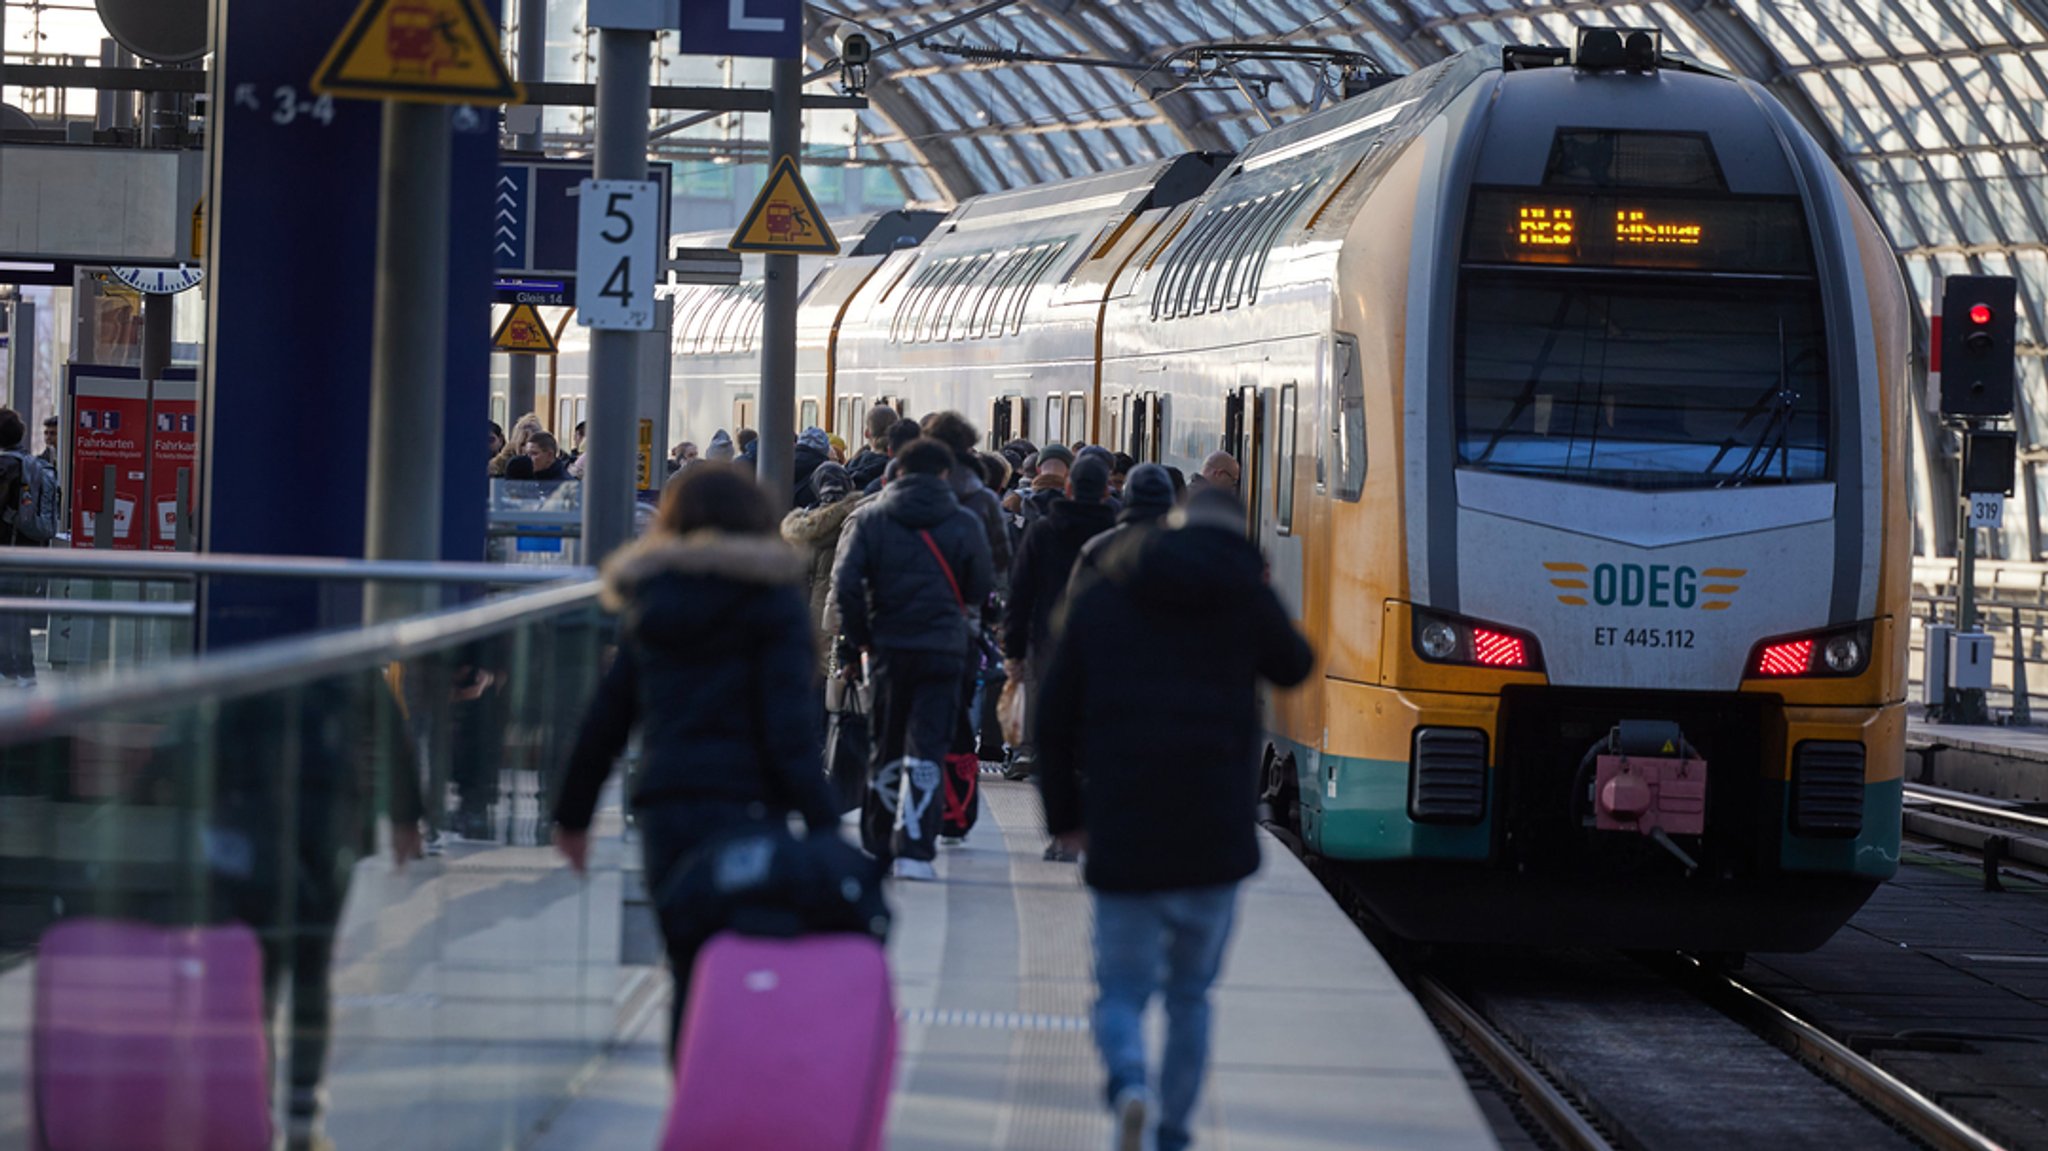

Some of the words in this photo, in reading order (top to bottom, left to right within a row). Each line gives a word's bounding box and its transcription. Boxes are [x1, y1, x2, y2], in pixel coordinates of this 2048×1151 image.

[273, 85, 335, 126] 3-4
[600, 193, 634, 244] 5
[1520, 208, 1572, 244] RE8
[516, 291, 546, 303] Gleis
[549, 294, 563, 305] 14
[598, 256, 634, 308] 4
[78, 436, 134, 449] Fahrkarten
[1975, 502, 1998, 520] 319
[1594, 563, 1697, 609] ODEG
[1594, 627, 1617, 646] ET
[1623, 628, 1695, 649] 445.112
